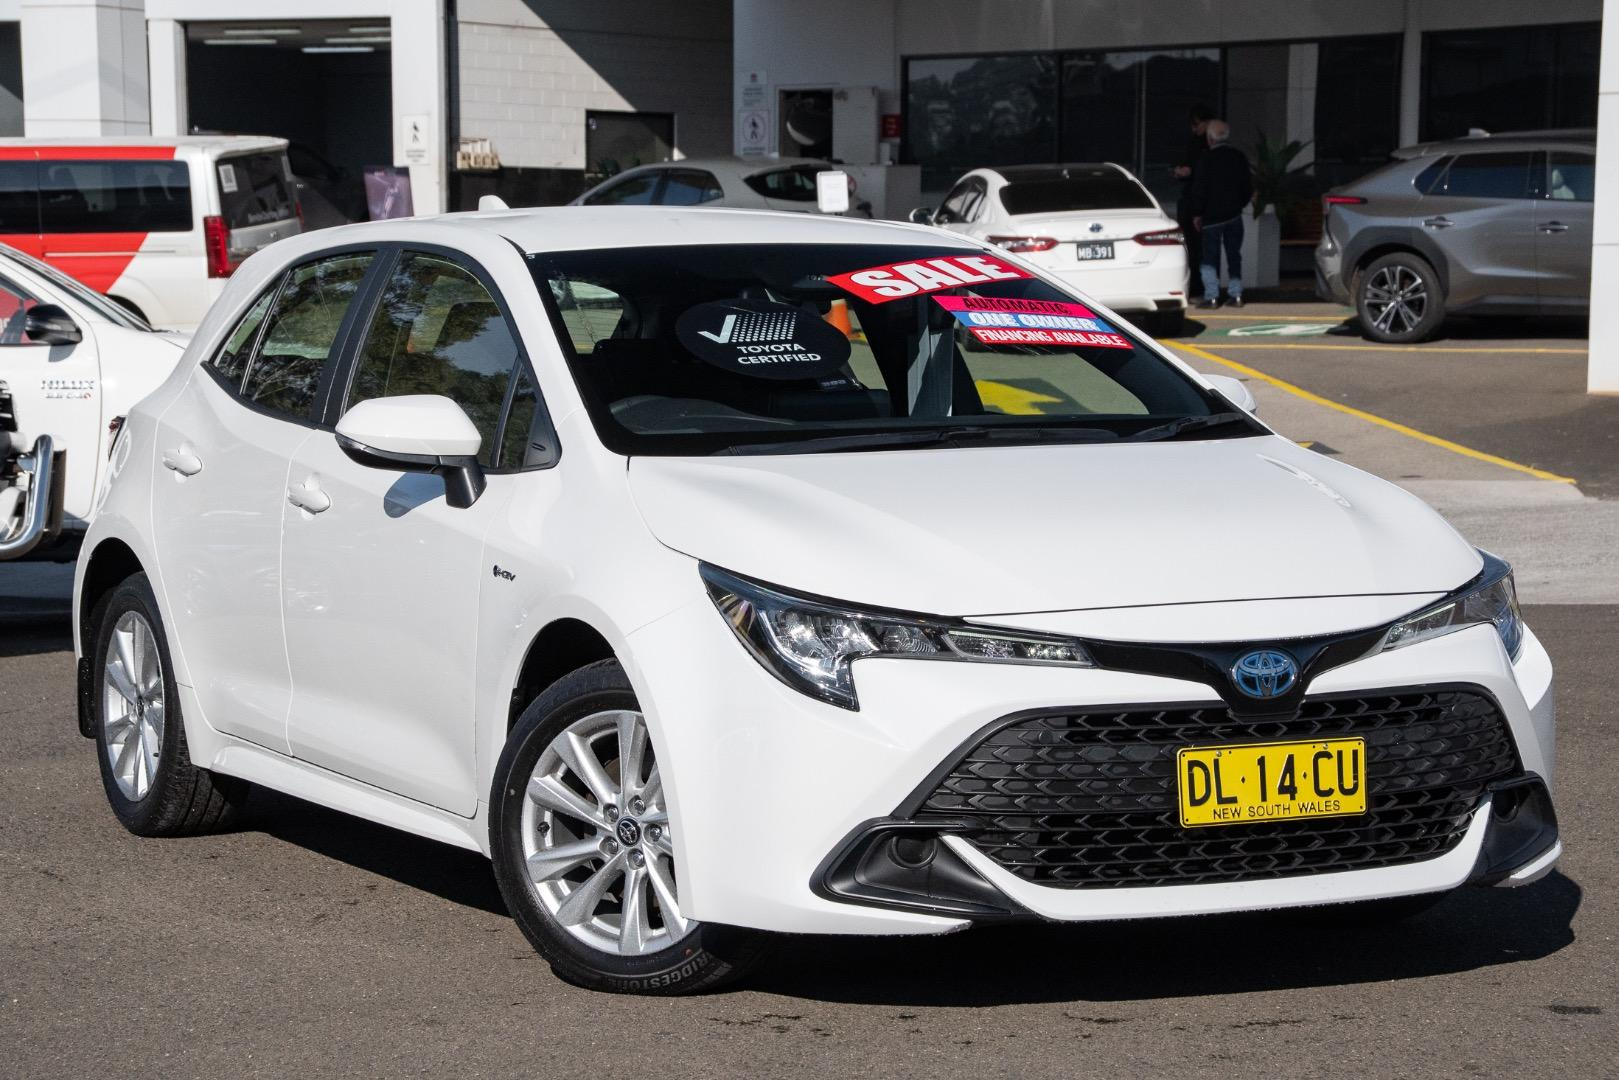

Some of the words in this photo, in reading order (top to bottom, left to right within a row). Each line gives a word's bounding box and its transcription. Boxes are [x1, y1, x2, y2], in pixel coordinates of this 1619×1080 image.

[850, 257, 1021, 297] SALE
[968, 312, 1020, 327] ONE
[1020, 314, 1101, 331] OWNER
[977, 329, 1053, 343] FINANCING
[1053, 332, 1128, 346] AVAILABLE
[737, 343, 806, 354] TOYOTA
[737, 353, 822, 365] CERTIFIED
[1213, 808, 1242, 820] NEW
[1248, 804, 1291, 817] SOUTH
[1298, 801, 1340, 813] WALES
